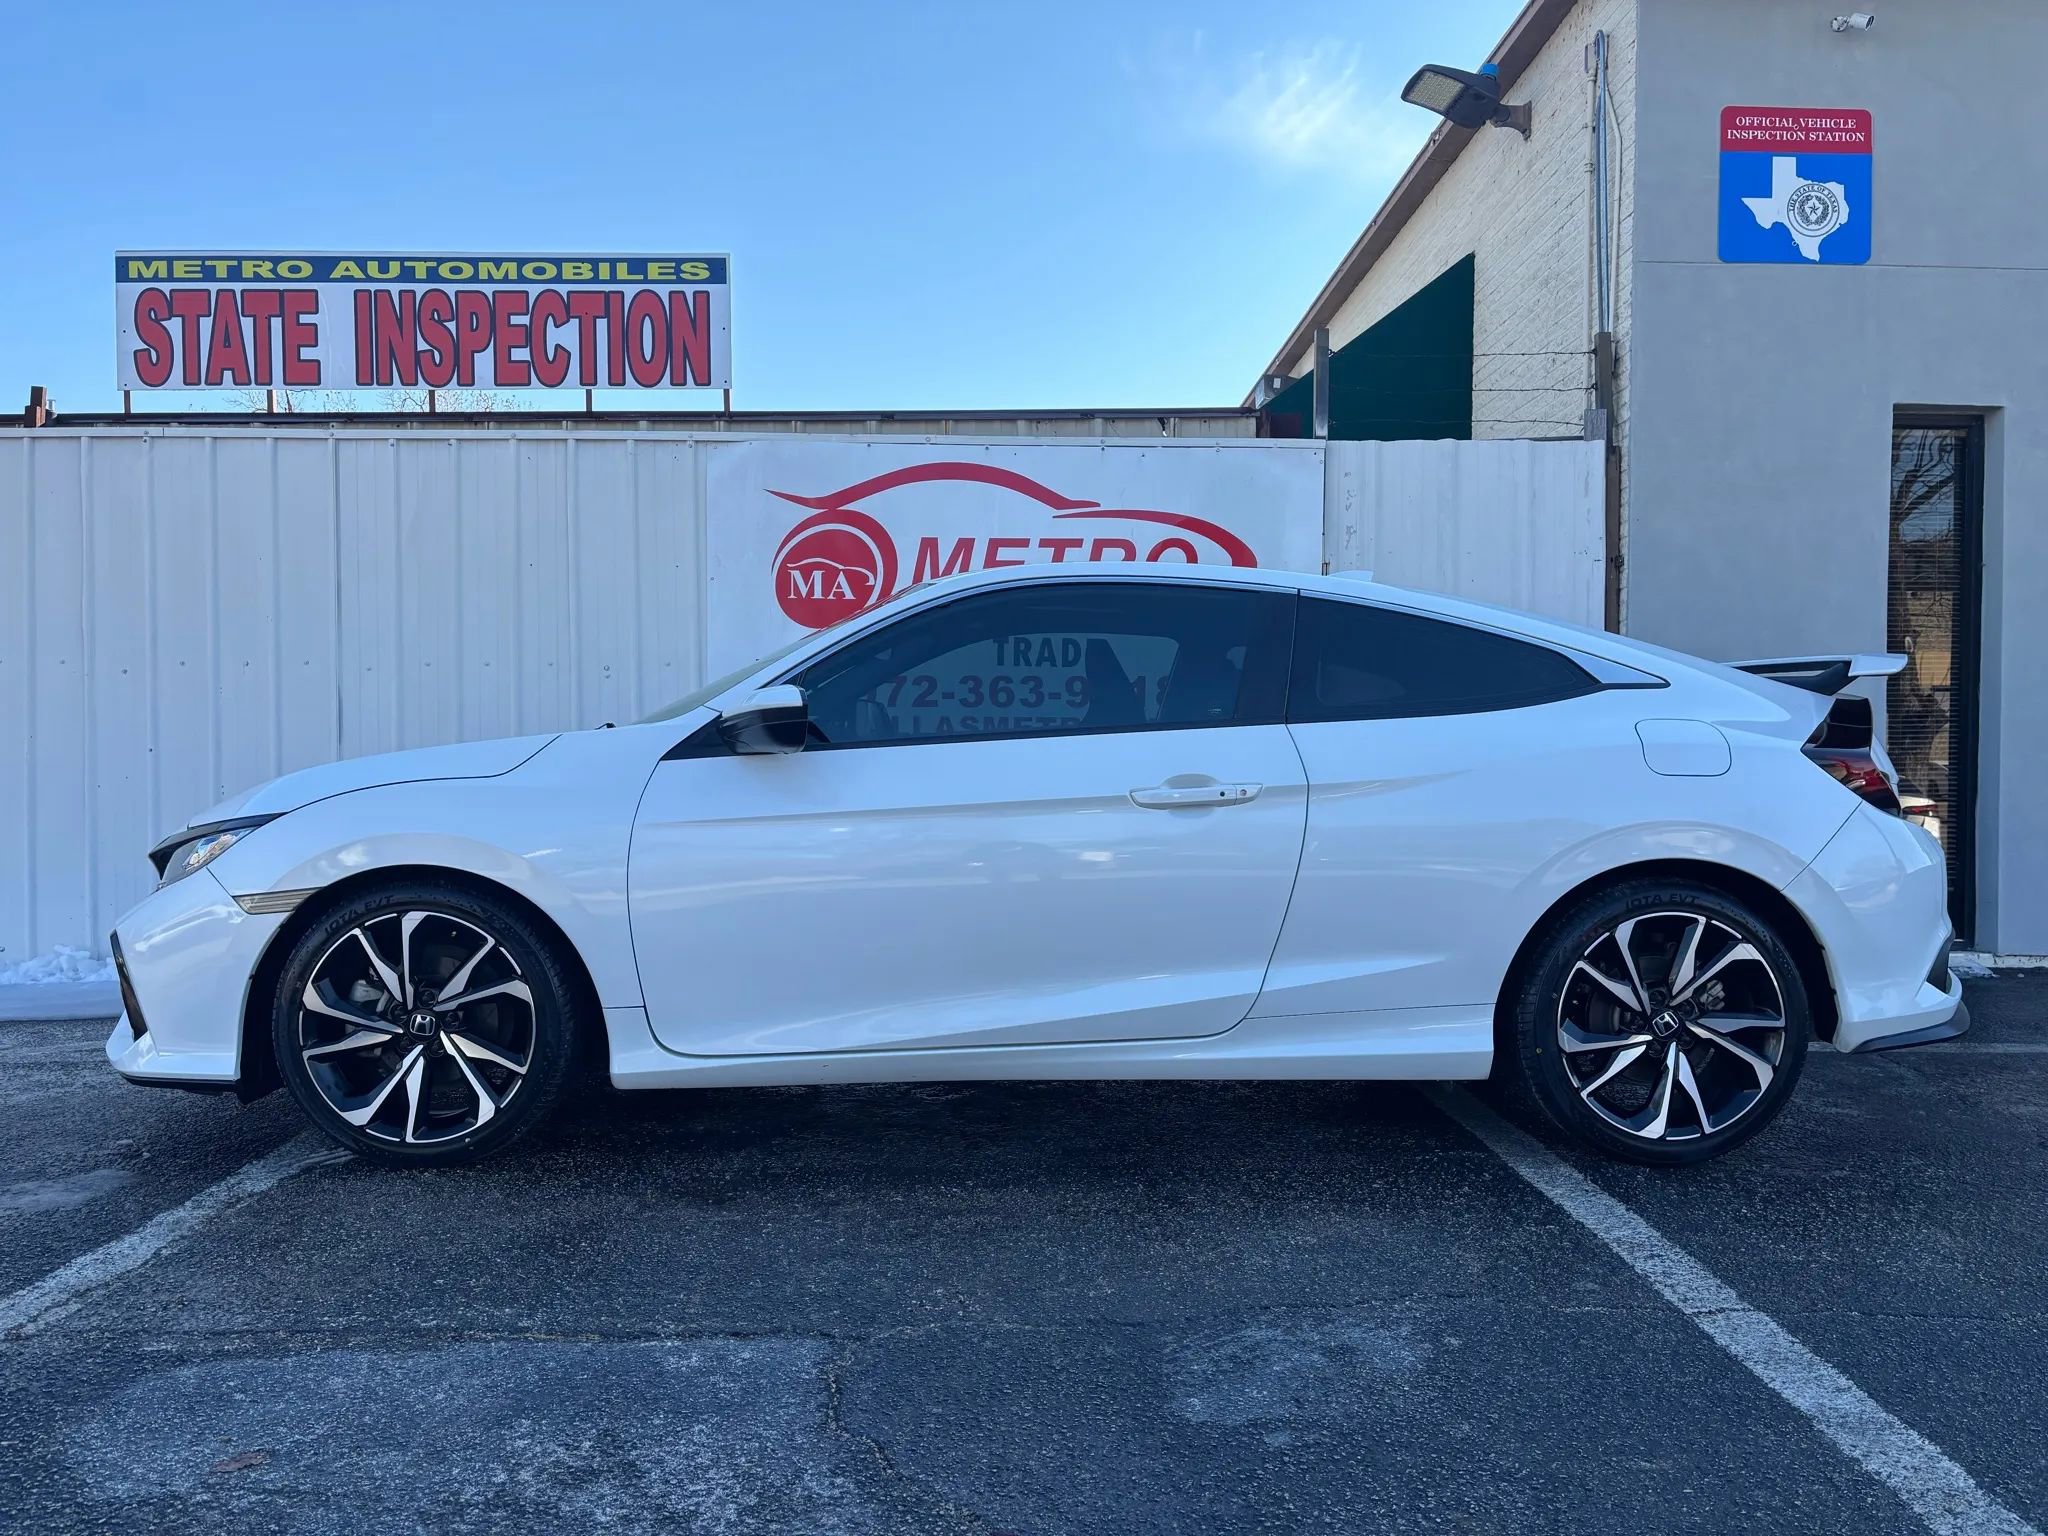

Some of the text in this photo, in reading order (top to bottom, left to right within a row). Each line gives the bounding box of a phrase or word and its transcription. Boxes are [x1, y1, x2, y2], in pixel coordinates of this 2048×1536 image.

[1736, 117, 1857, 129] OFFICIAL VEHICLE
[1727, 130, 1865, 142] INSPECTION STATION
[1795, 185, 1815, 197] STATE
[1827, 192, 1838, 214] TEXAS
[127, 260, 711, 280] METRO AUTOMOBILES
[133, 287, 711, 388] STATE INSPECTION
[787, 569, 856, 600] MA
